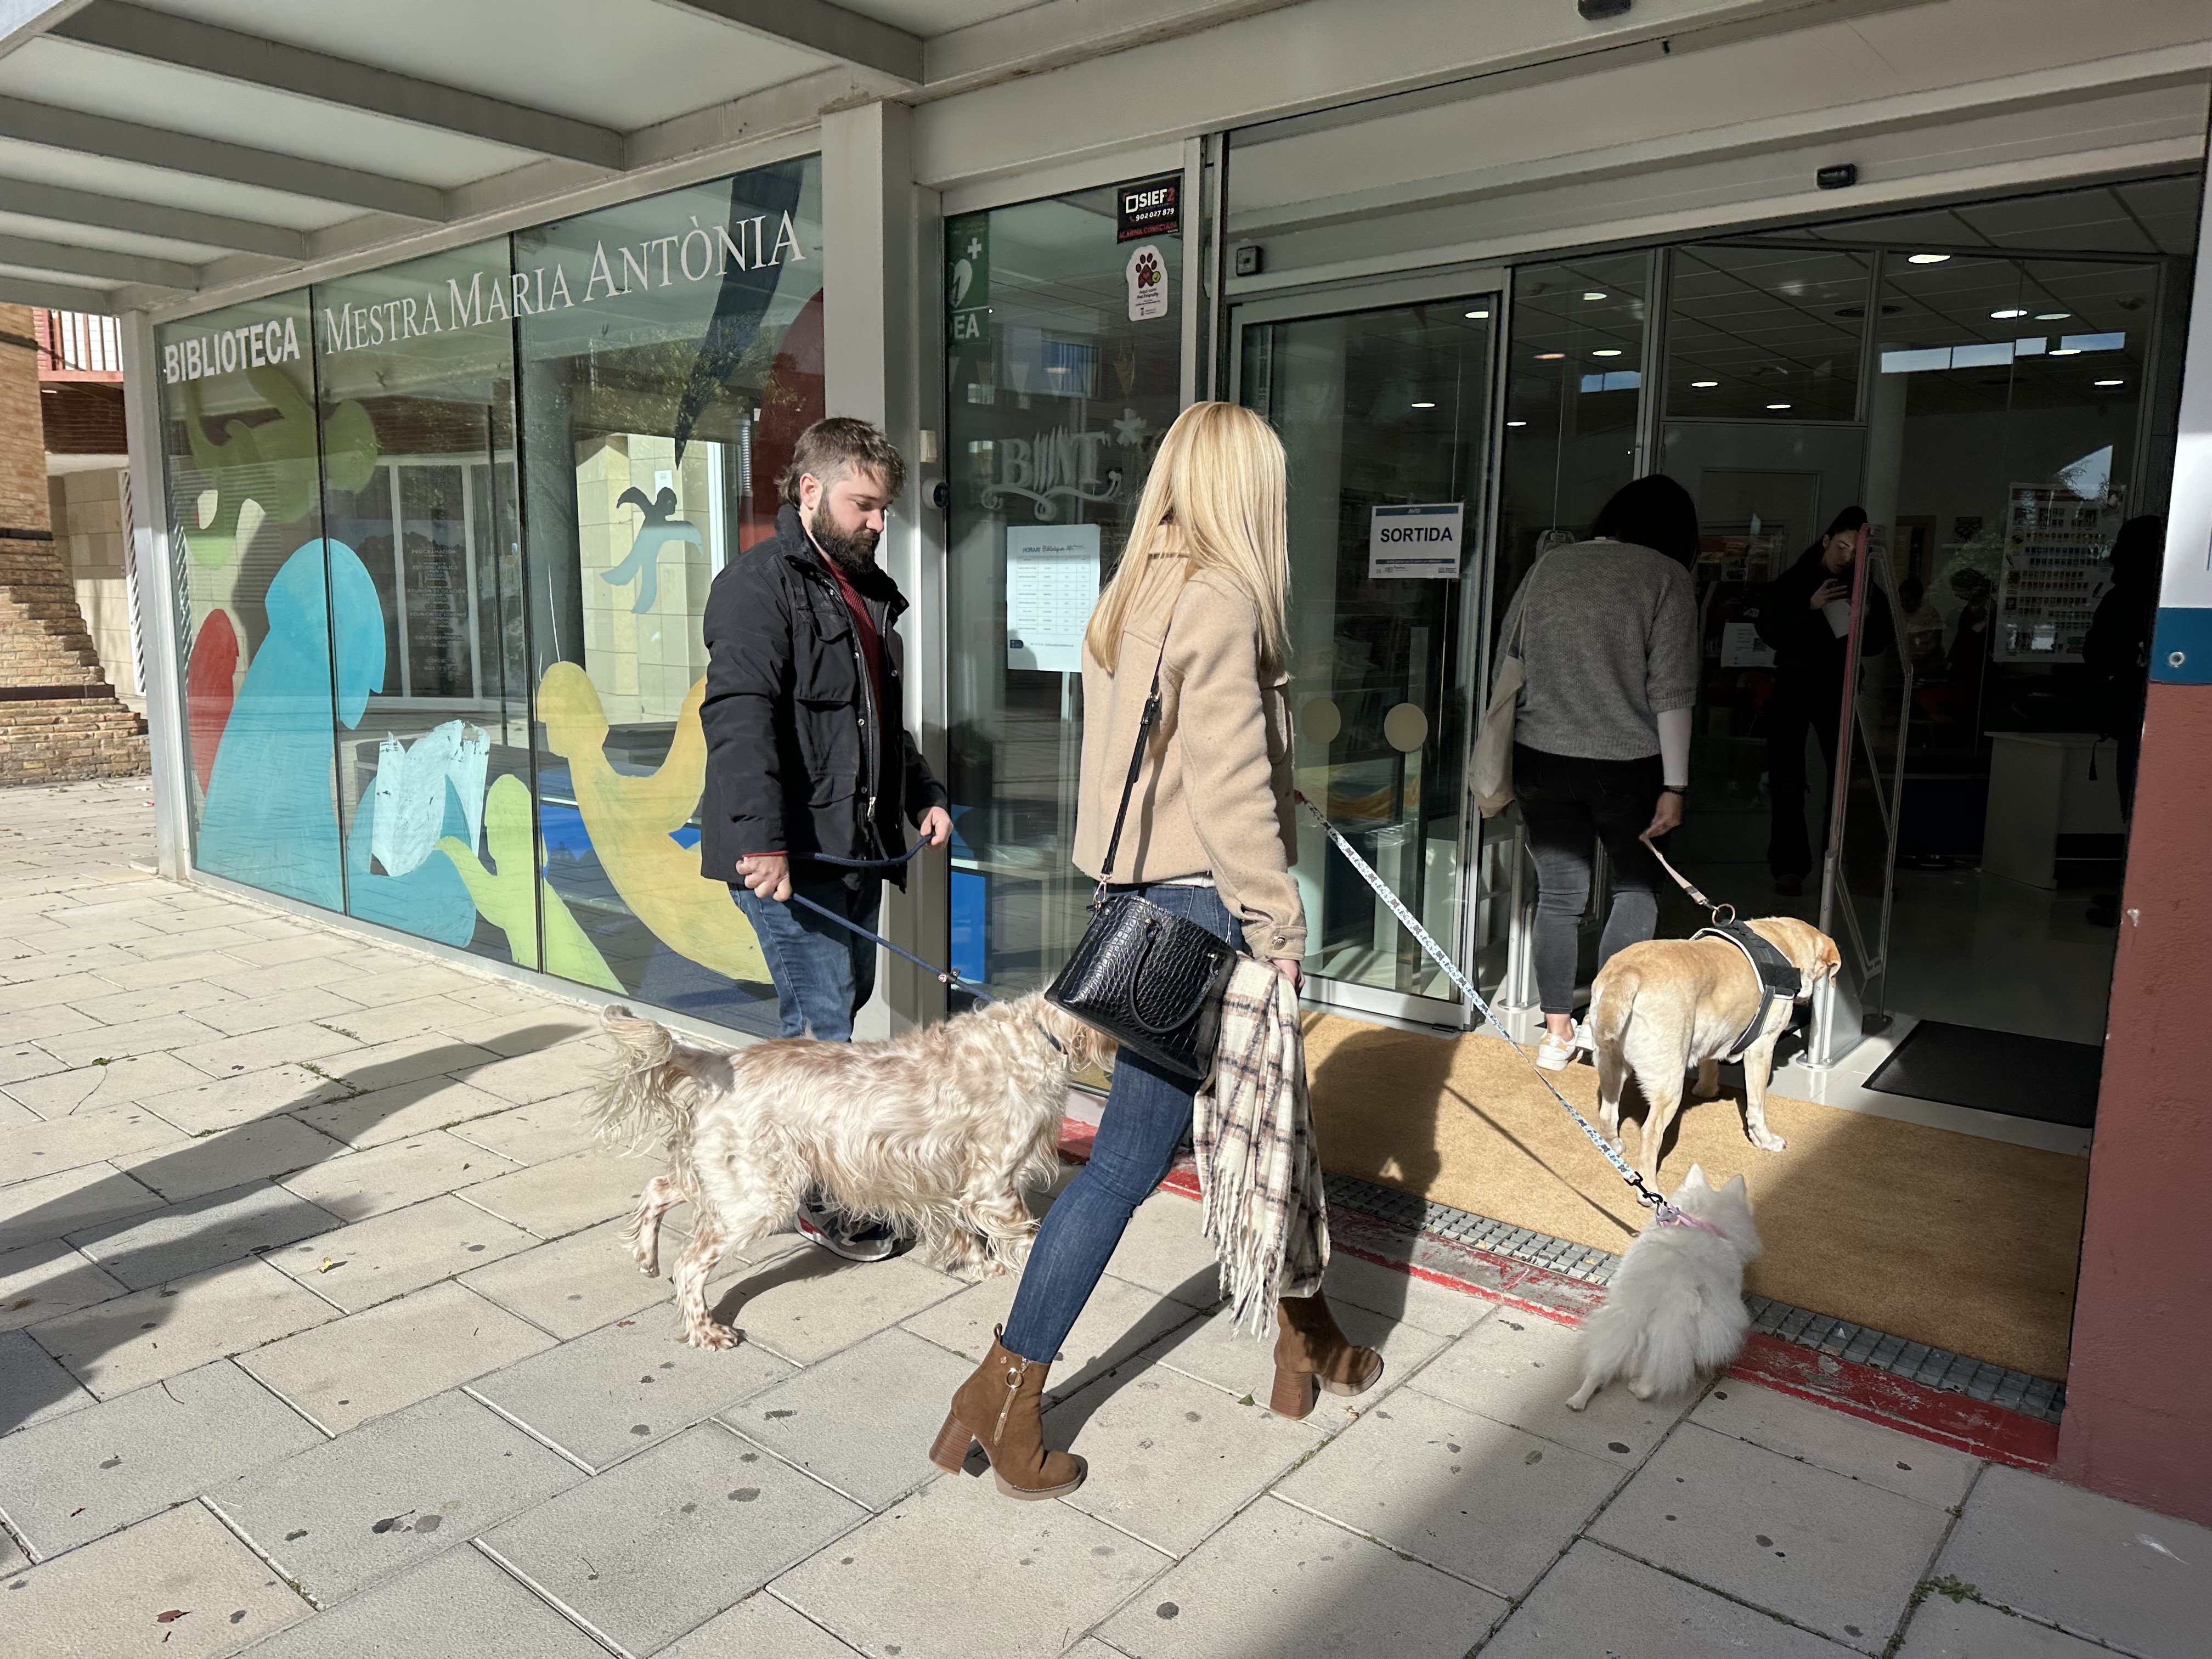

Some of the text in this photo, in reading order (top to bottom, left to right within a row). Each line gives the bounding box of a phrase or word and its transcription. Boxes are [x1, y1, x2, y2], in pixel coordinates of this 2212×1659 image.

[1136, 213, 1148, 222] 902
[1163, 208, 1174, 216] 879
[165, 210, 806, 384] BIBLIOTECA MESTRA MARIA ANTÒNIA
[1380, 527, 1453, 543] SORTIDA
